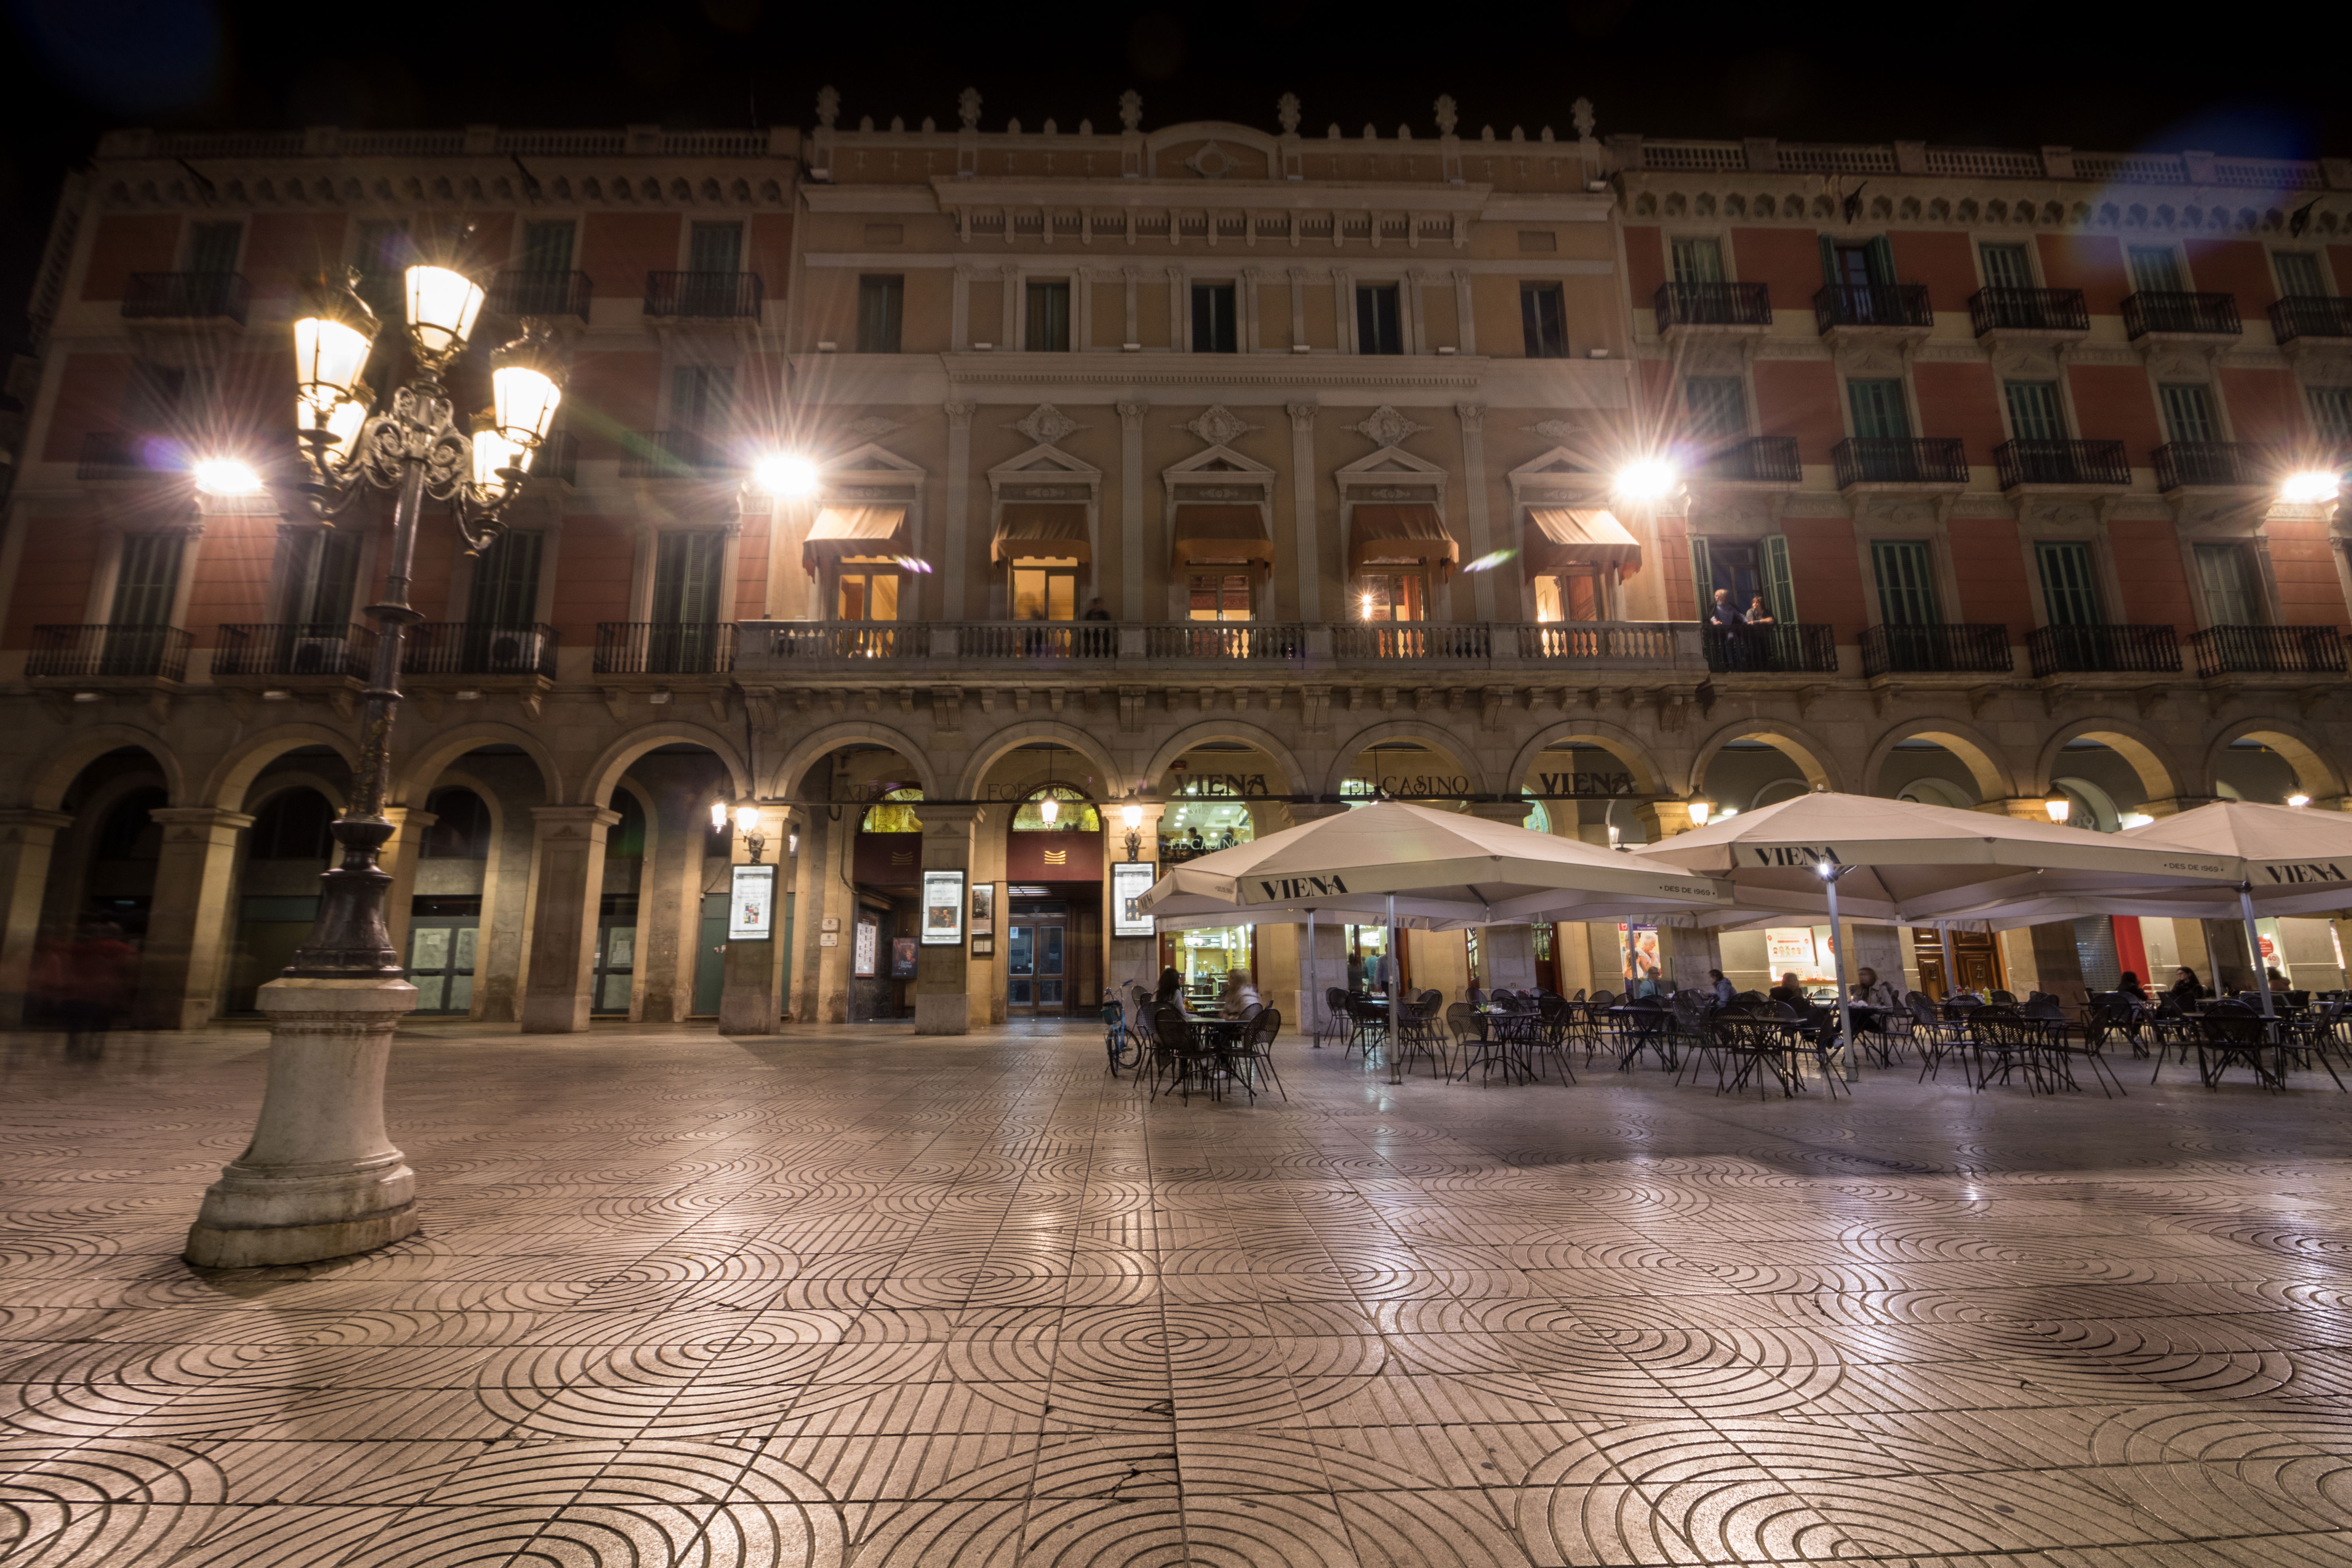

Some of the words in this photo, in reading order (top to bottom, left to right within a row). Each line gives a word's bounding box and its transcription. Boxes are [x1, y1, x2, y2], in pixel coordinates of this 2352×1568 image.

[1174, 774, 1269, 794] VIENA
[1346, 777, 1375, 794] EL
[1382, 775, 1469, 794] CASINO
[1539, 773, 1635, 792] VIENA
[1754, 847, 1842, 866] VIENA
[2265, 864, 2347, 883] VIENA
[1260, 875, 1349, 900] VIENA
